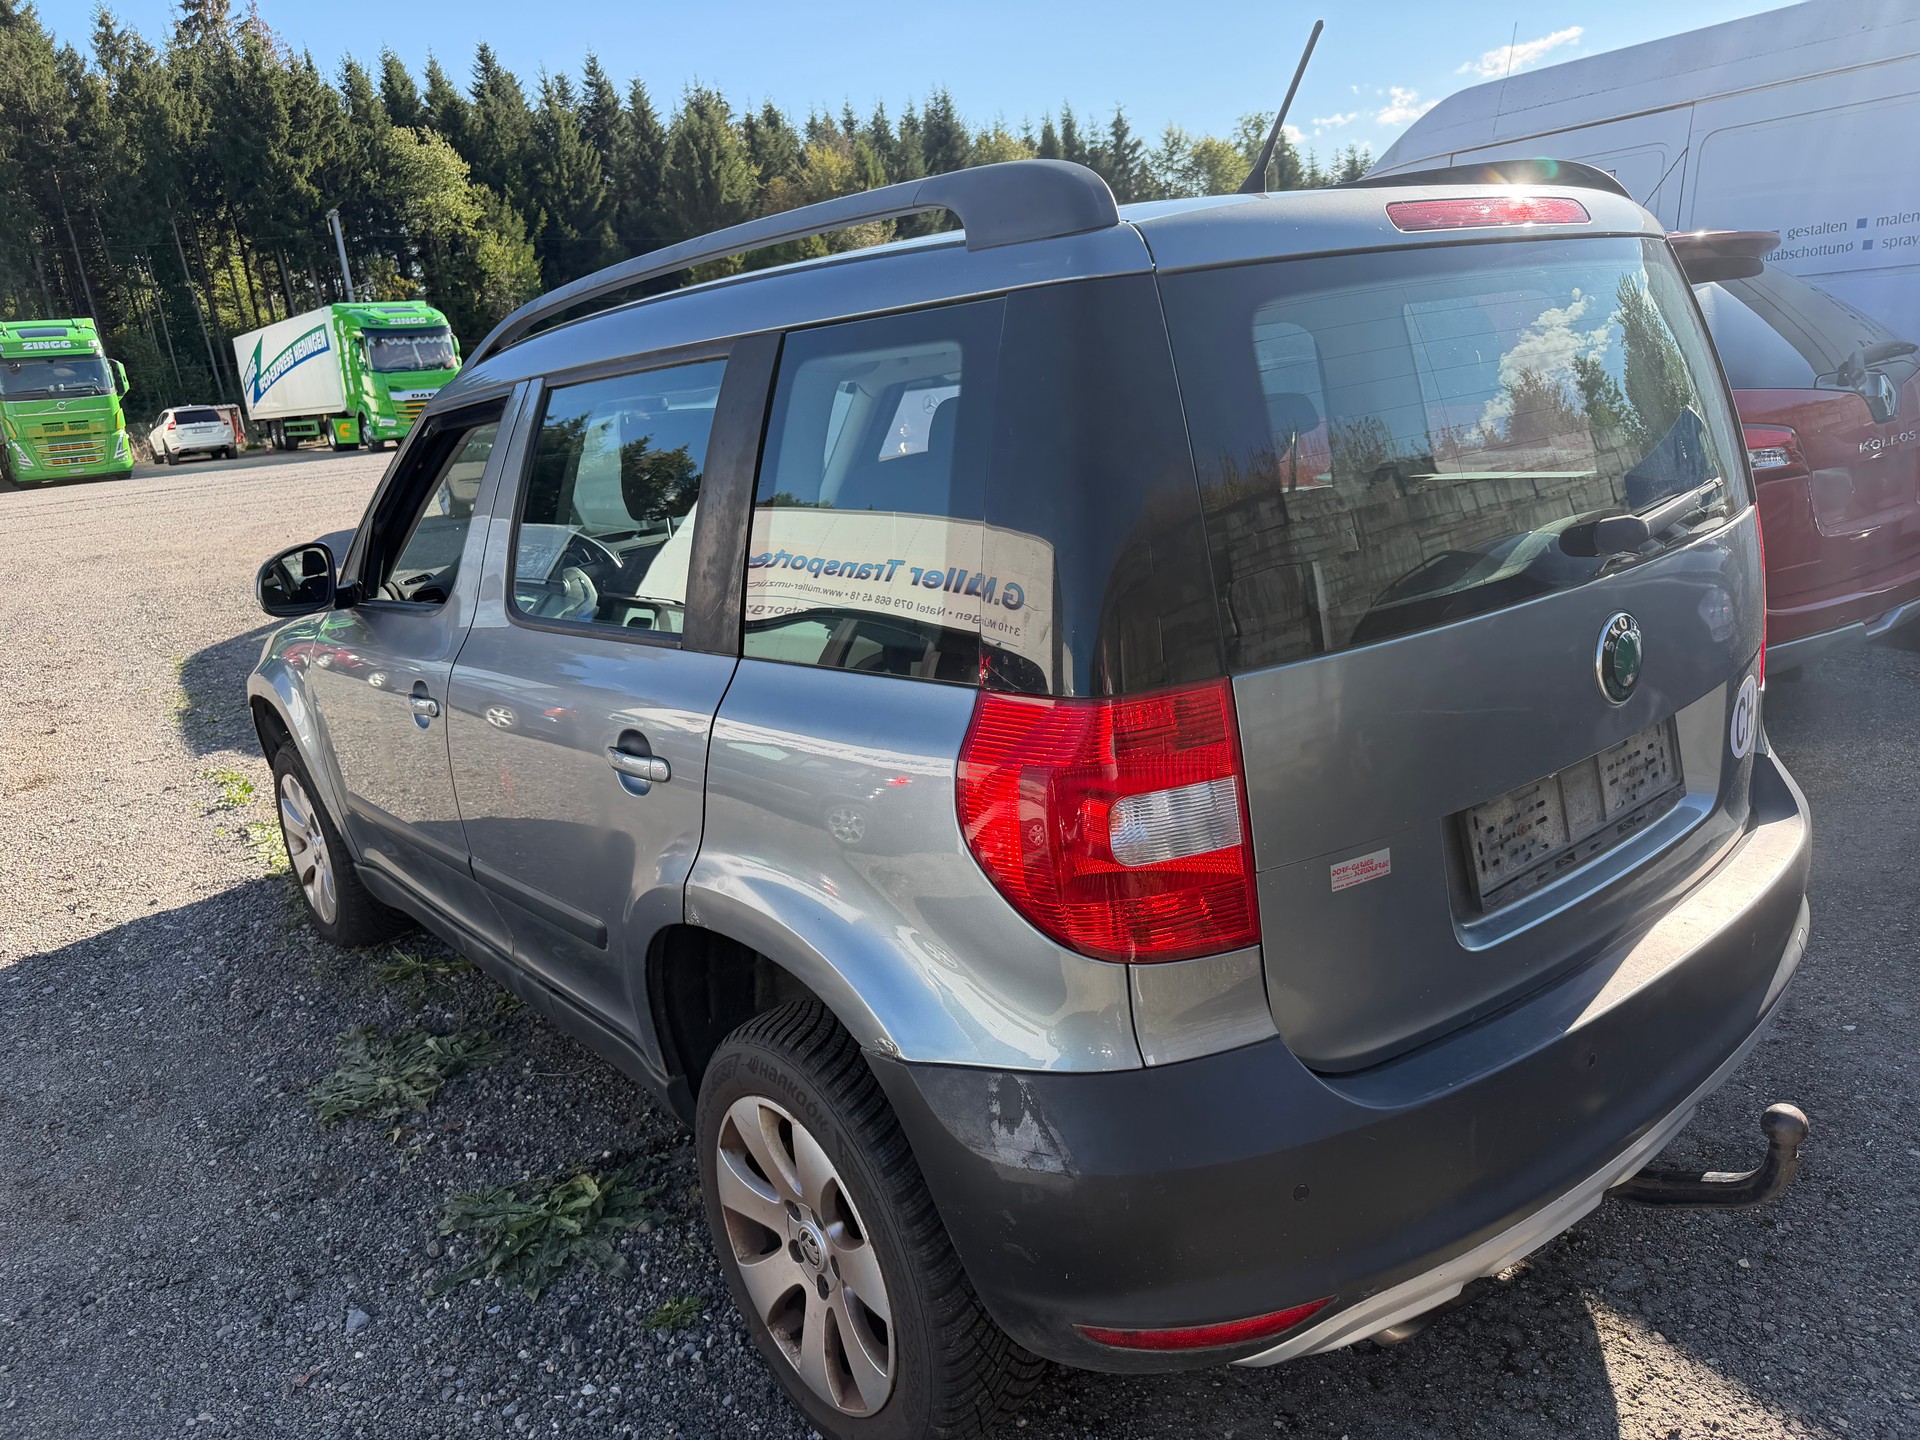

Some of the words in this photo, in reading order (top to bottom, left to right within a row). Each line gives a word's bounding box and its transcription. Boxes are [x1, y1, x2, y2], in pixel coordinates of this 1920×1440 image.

[1787, 221, 1848, 241] gestalten
[1876, 212, 1920, 227] malen
[1881, 234, 1920, 250] spray
[389, 317, 428, 325] ZINGG
[22, 340, 72, 350] ZINGG
[1859, 430, 1917, 453] KOLEOS
[1736, 684, 1756, 750] CH
